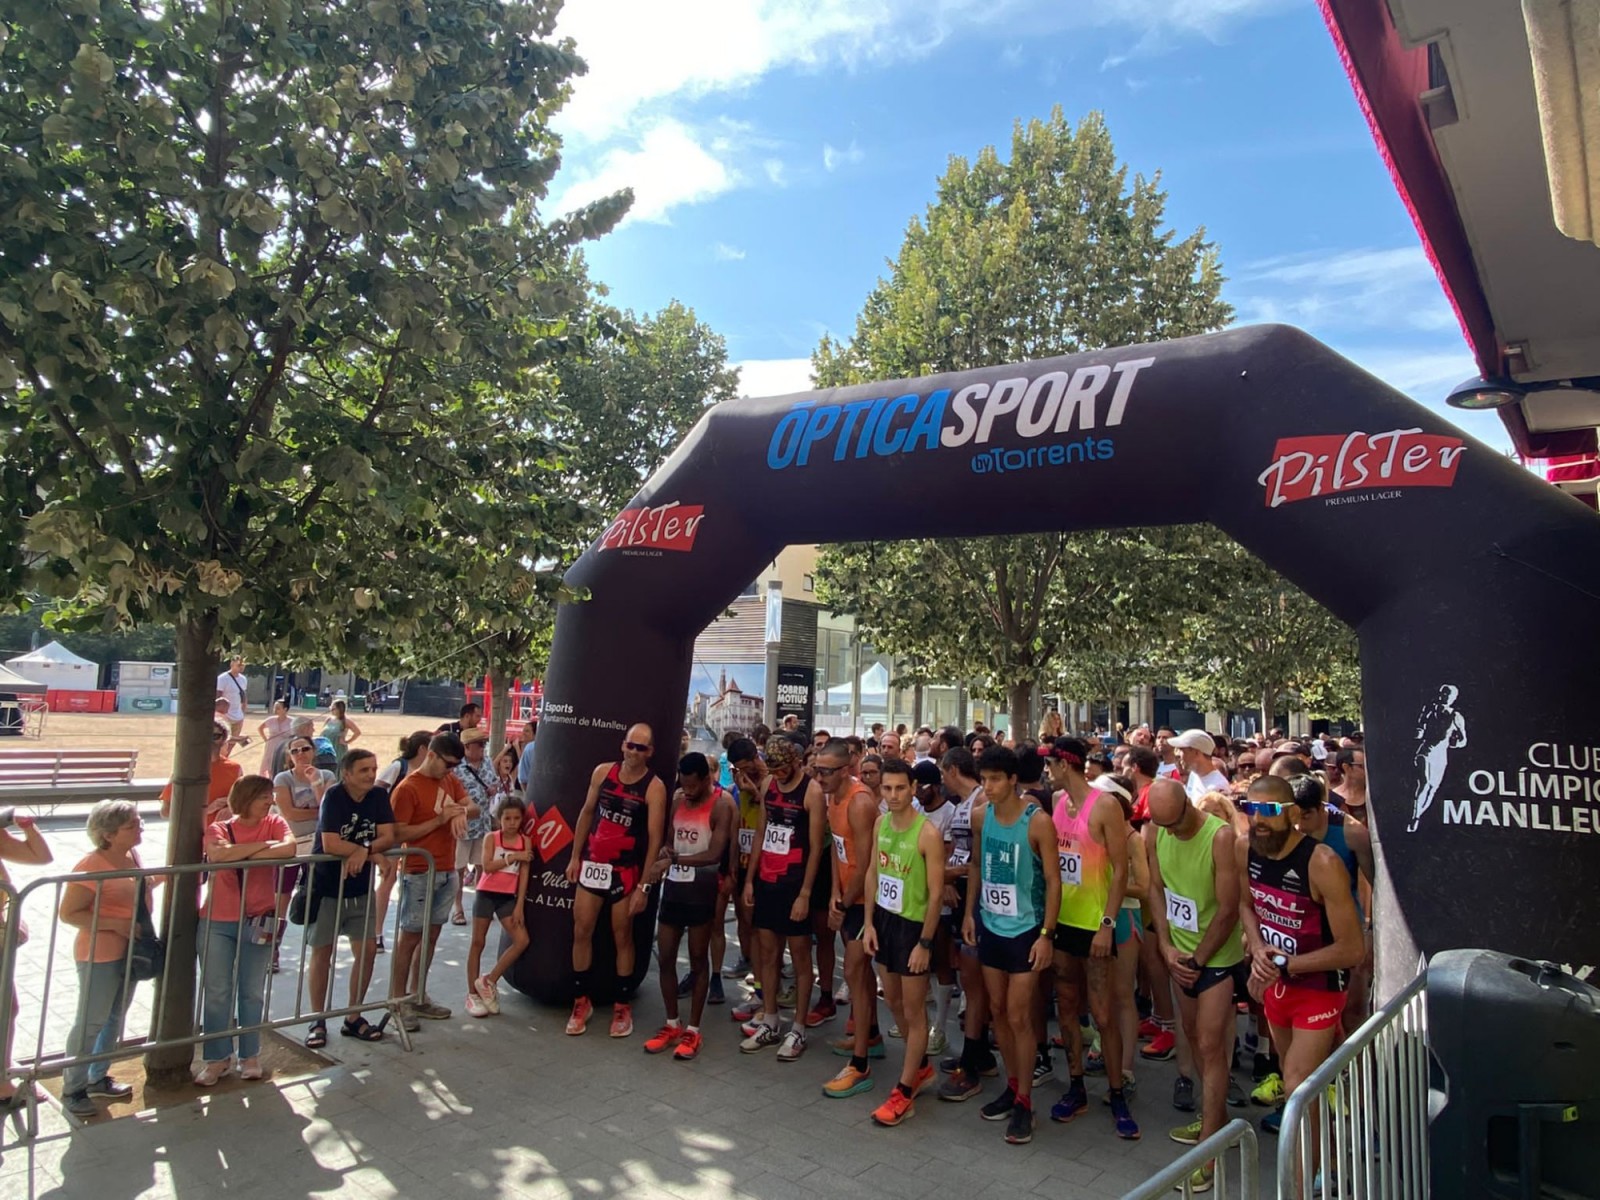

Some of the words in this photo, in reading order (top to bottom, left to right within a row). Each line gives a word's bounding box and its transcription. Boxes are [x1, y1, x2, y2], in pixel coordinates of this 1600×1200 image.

[1325, 494, 1369, 507] PREMIUM
[1371, 490, 1403, 501] LAGER
[777, 684, 808, 695] SOBREN
[777, 694, 808, 704] MOTIUS
[545, 701, 574, 714] Esports
[543, 713, 577, 725] Ajuntament
[578, 716, 590, 726] de
[591, 717, 627, 731] Manlleu
[612, 812, 632, 827] ETB
[585, 866, 608, 881] 005
[880, 881, 898, 900] 196
[985, 889, 1011, 906] 195
[1308, 1007, 1339, 1024] SPALL
